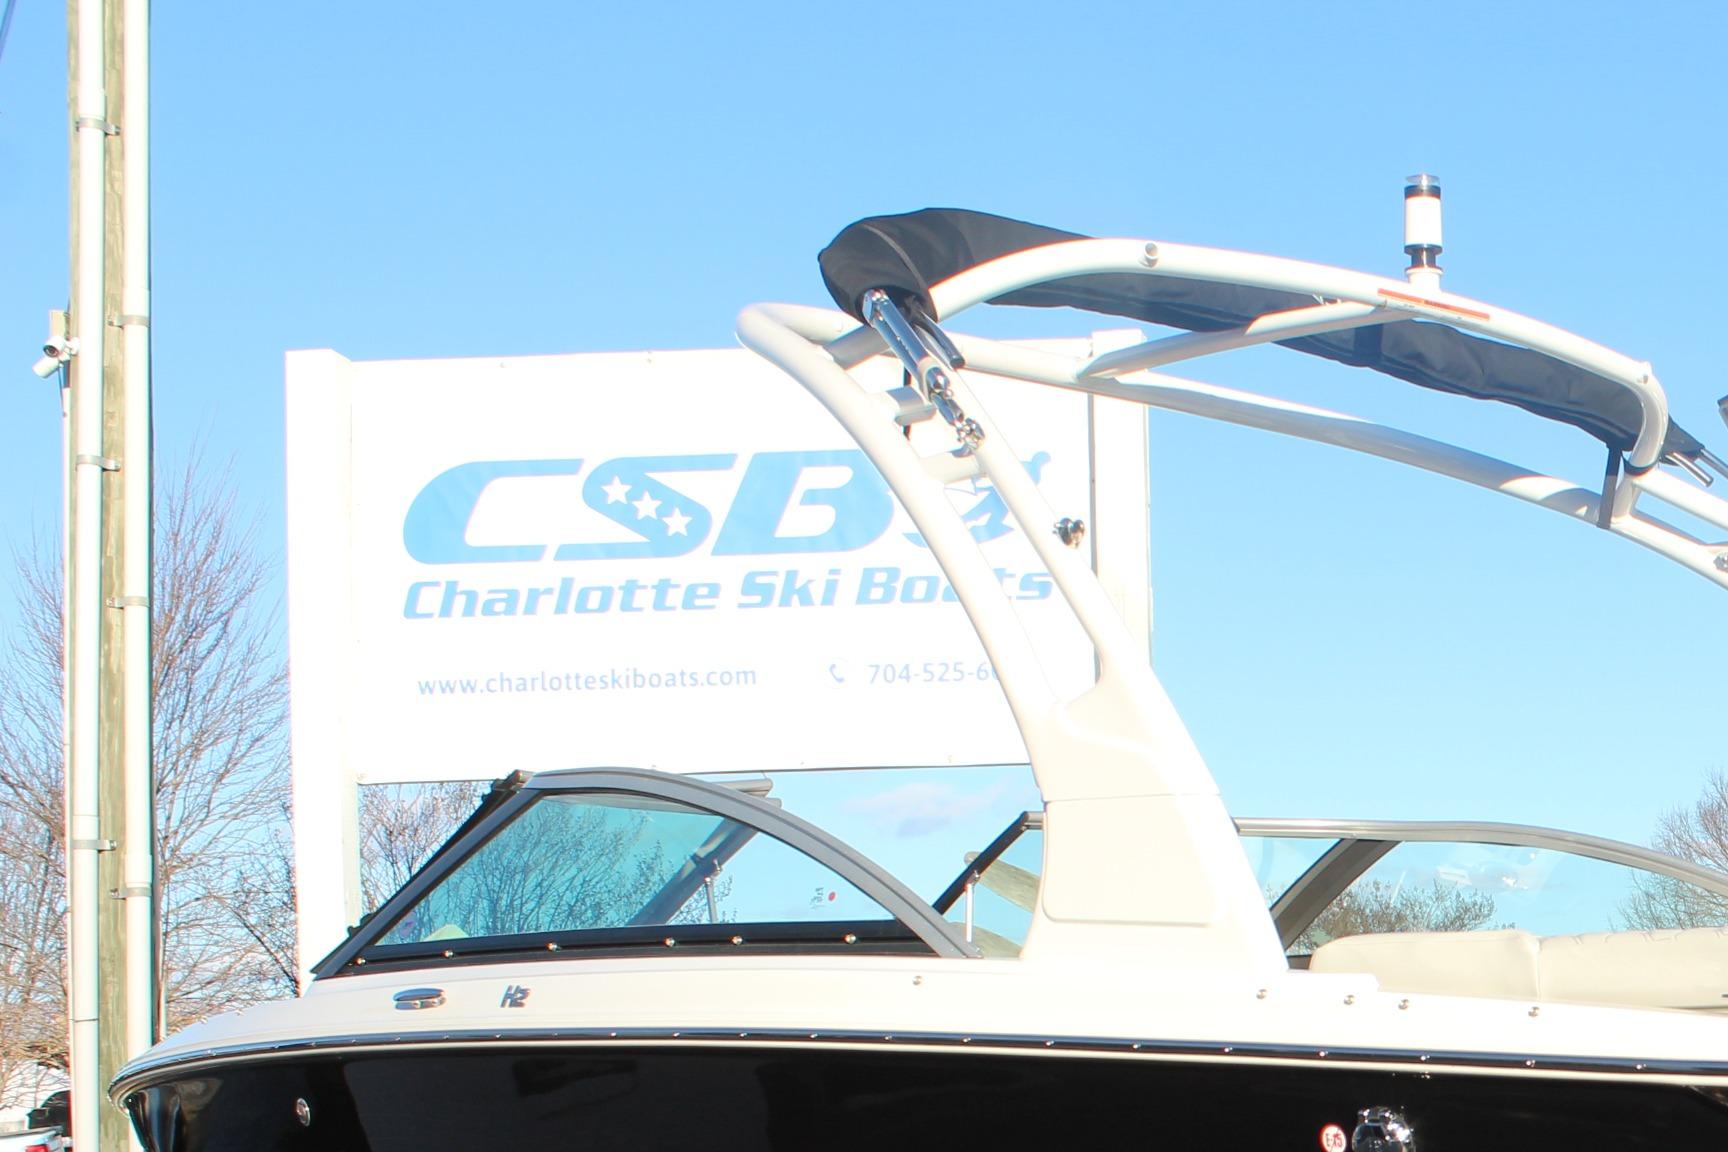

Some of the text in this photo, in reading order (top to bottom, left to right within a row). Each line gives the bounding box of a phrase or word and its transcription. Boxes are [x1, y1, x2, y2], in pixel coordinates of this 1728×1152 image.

[402, 448, 894, 565] CSB
[403, 576, 721, 619] Charlotte
[737, 568, 842, 609] Ski
[417, 667, 757, 696] www.charlotteskiboats.com
[500, 984, 531, 1009] H2
